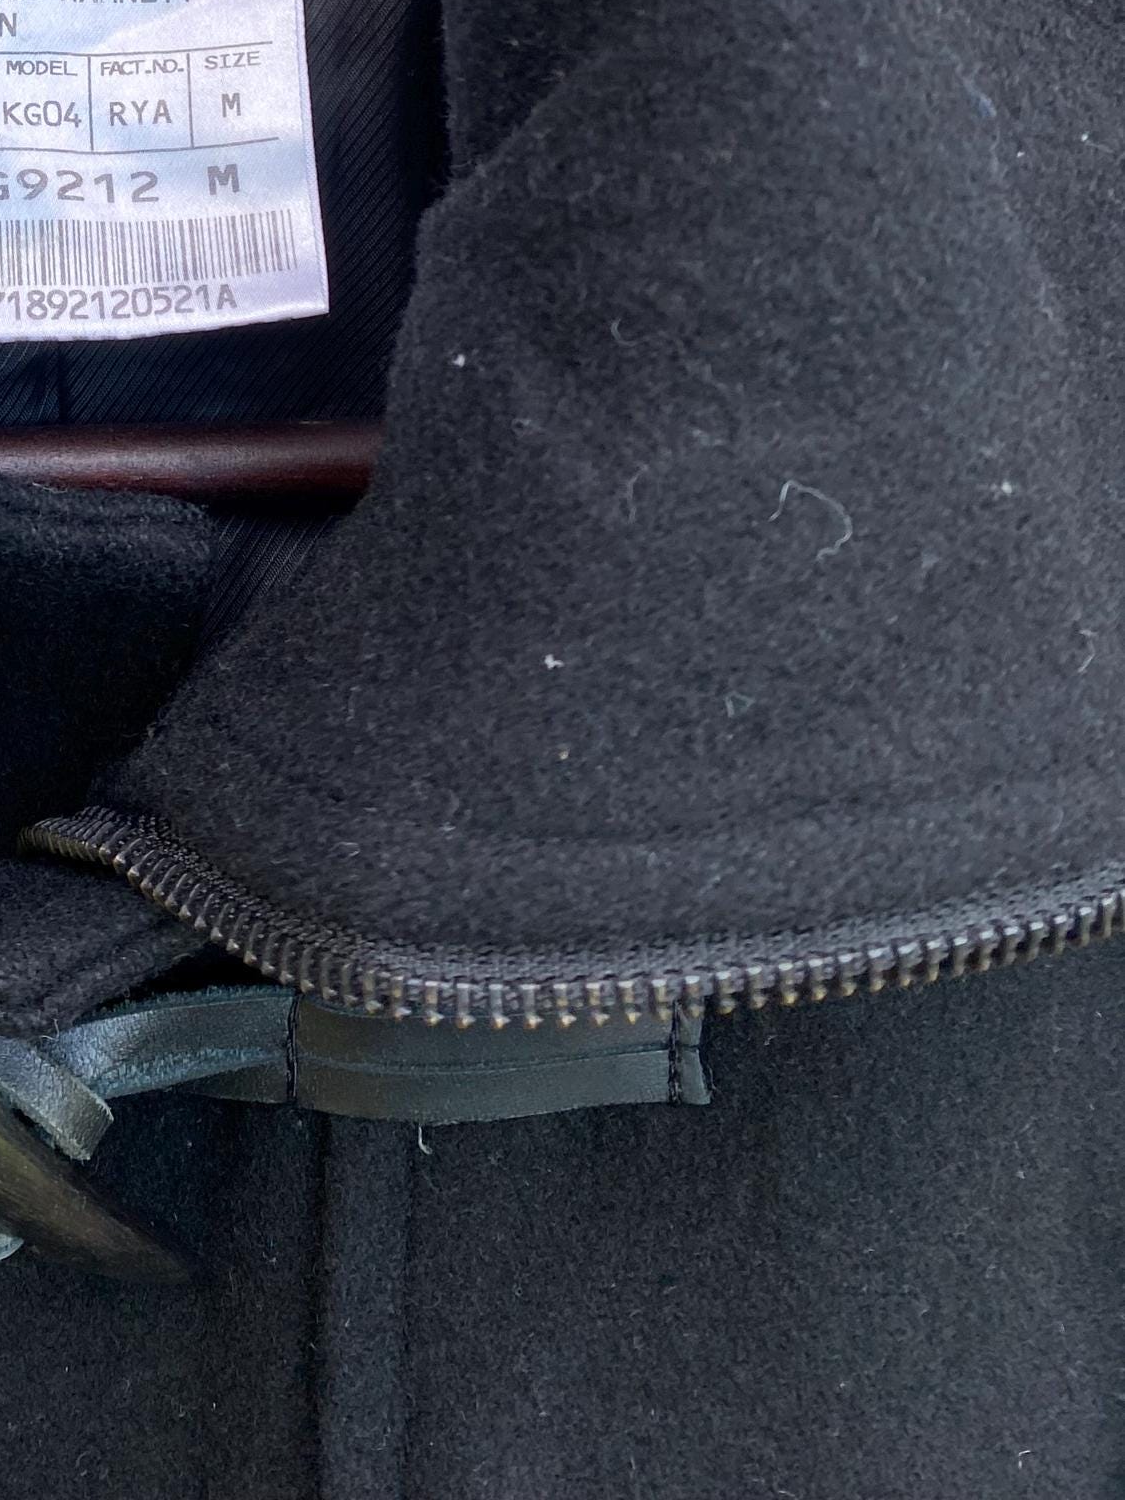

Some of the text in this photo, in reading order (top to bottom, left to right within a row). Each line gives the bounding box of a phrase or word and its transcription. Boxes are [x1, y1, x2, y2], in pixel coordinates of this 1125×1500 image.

[6, 60, 77, 76] MODEL
[100, 59, 185, 76] FACT.NO.
[204, 51, 261, 71] SIZE
[109, 99, 172, 126] RYA
[221, 93, 241, 118] M
[207, 164, 240, 195] M
